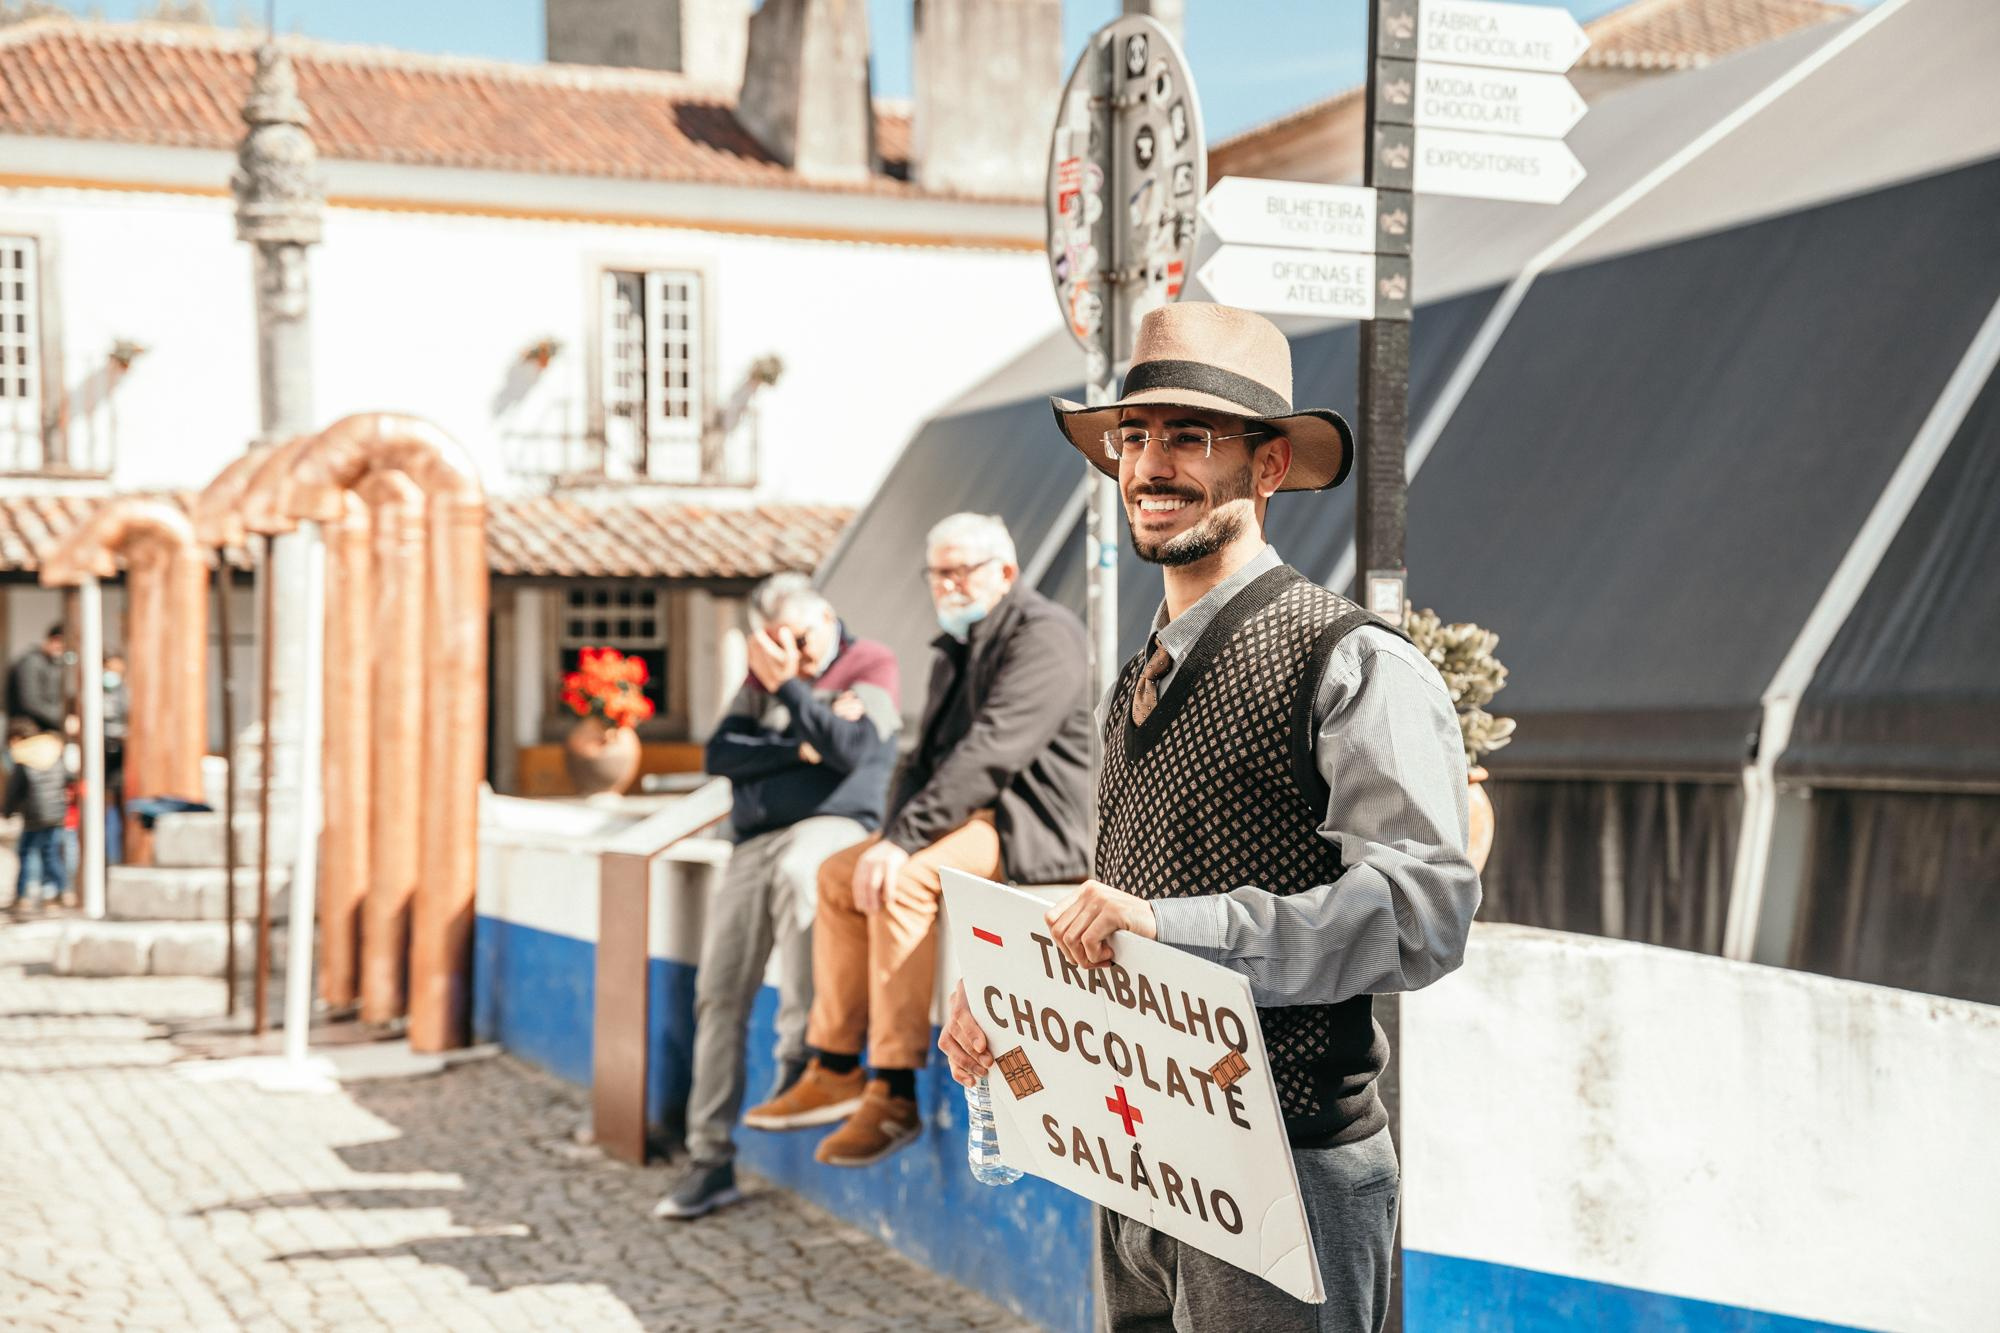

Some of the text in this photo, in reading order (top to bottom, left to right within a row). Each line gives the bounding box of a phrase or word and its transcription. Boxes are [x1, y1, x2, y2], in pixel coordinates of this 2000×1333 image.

[1427, 32, 1552, 60] DE CHOCOLATE
[1425, 77, 1518, 102] MODA COM
[1424, 99, 1521, 125] CHOCOLATE
[1425, 148, 1540, 176] EXPOSITORES
[1265, 196, 1365, 219] BILHETEIRA
[1272, 262, 1366, 285] OFICINAS E
[1286, 285, 1367, 306] ATELIERS
[1030, 932, 1248, 1053] TRABALHO
[984, 985, 1251, 1130] CHOCOLATE
[1042, 1113, 1243, 1235] SALÁRIO
